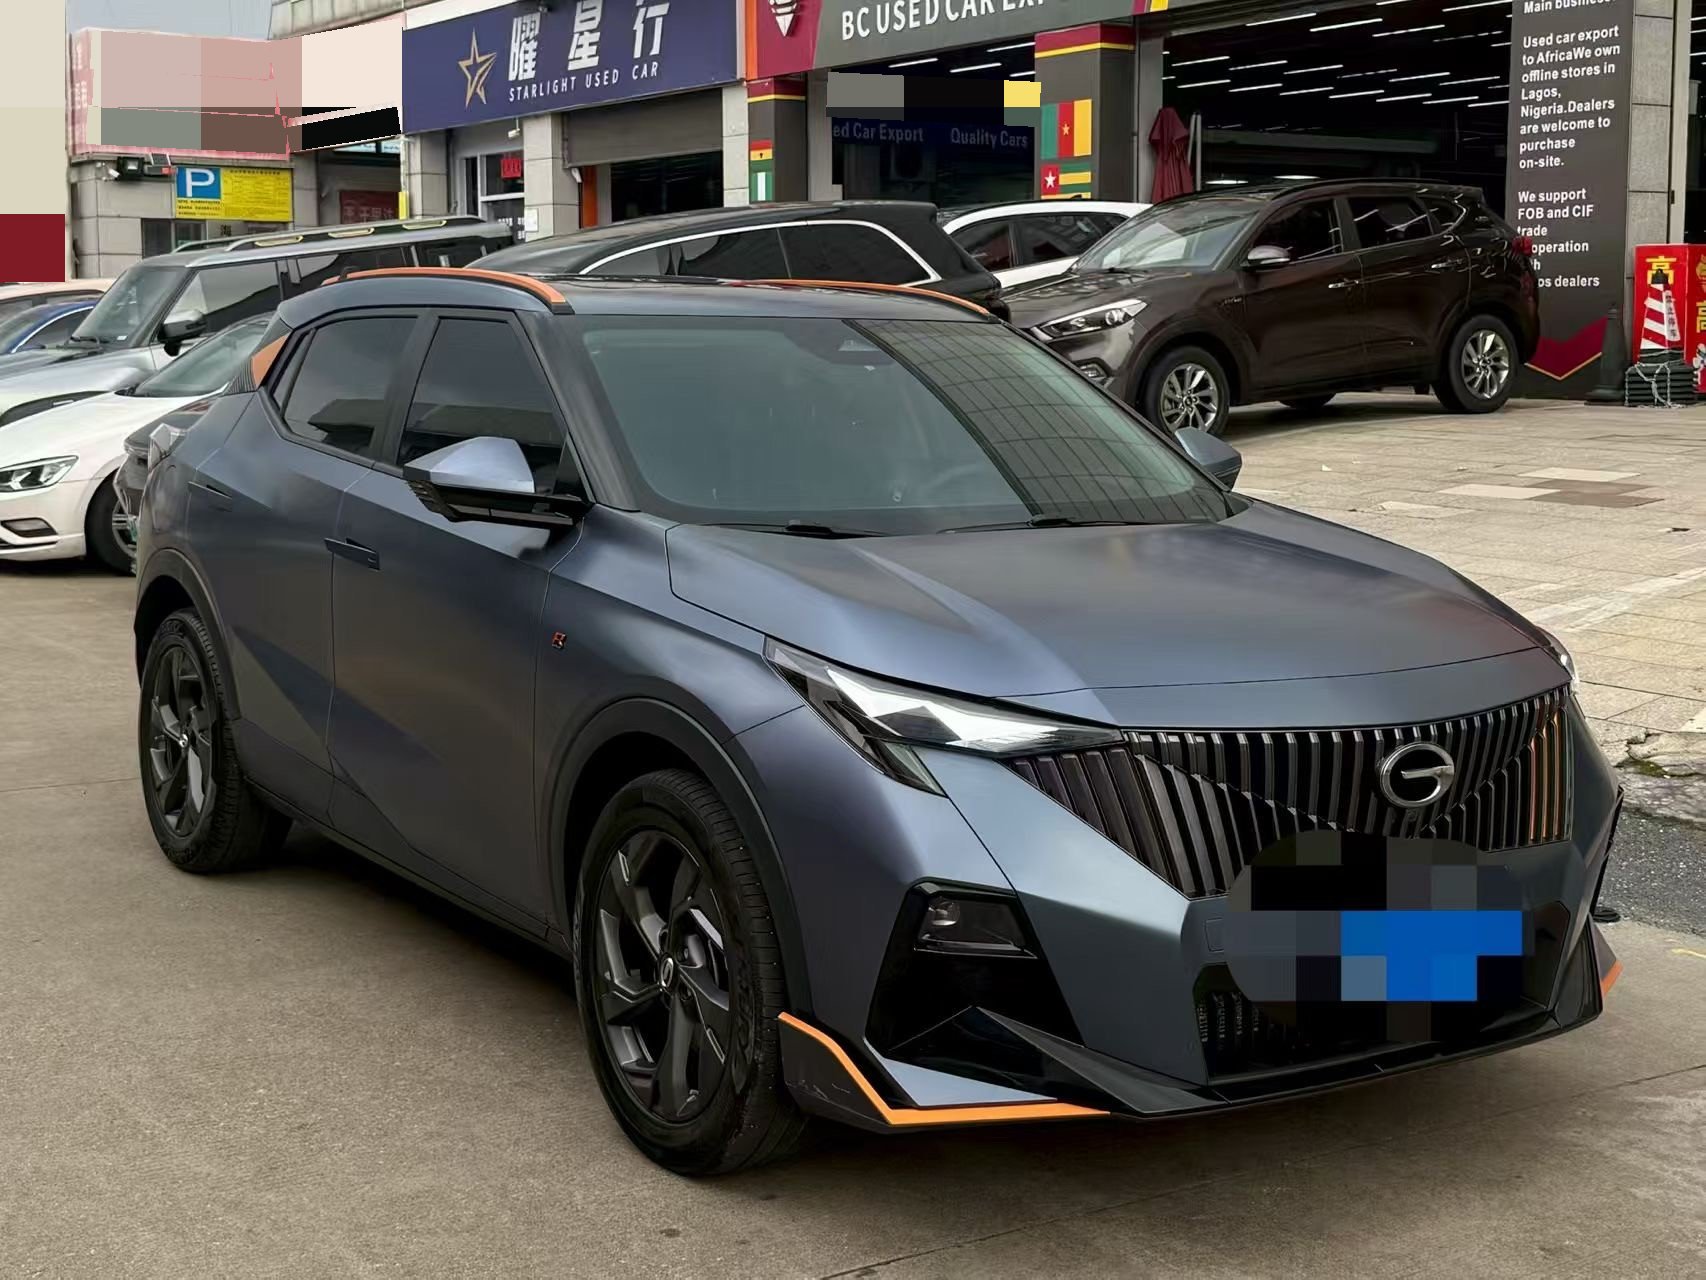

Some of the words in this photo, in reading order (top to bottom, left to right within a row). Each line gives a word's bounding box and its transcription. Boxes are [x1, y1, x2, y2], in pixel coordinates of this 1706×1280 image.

[1523, 0, 1552, 14] Main
[842, 7, 870, 40] BC
[876, 0, 939, 34] USED
[1523, 33, 1553, 48] Used
[1556, 32, 1576, 44] car
[1578, 25, 1619, 42] export
[1522, 54, 1534, 66] to
[1536, 47, 1591, 64] AfricaWe
[1594, 45, 1620, 57] own
[509, 76, 577, 102] STARLIGHT
[585, 69, 619, 89] USED
[632, 62, 659, 80] CAR
[1522, 67, 1559, 83] offline
[1561, 63, 1600, 79] stores
[1603, 62, 1616, 74] in
[1521, 87, 1561, 101] Lagos,
[1520, 99, 1615, 119] Nigeria.Dealers
[853, 123, 875, 139] Car
[879, 124, 924, 144] Export
[1520, 123, 1538, 134] are
[1541, 118, 1595, 133] welcome
[1598, 117, 1611, 128] to
[951, 127, 997, 150] Quality
[1000, 130, 1028, 148] Cars
[1519, 136, 1576, 154] purchase
[1519, 155, 1564, 168] on-site.
[185, 168, 215, 197] P
[1518, 191, 1536, 203] We
[1538, 188, 1586, 204] support
[1518, 207, 1544, 220] FOB
[1547, 205, 1569, 219] and
[1572, 204, 1594, 218] CIF
[1532, 240, 1589, 256] operation
[1554, 275, 1600, 288] dealers
